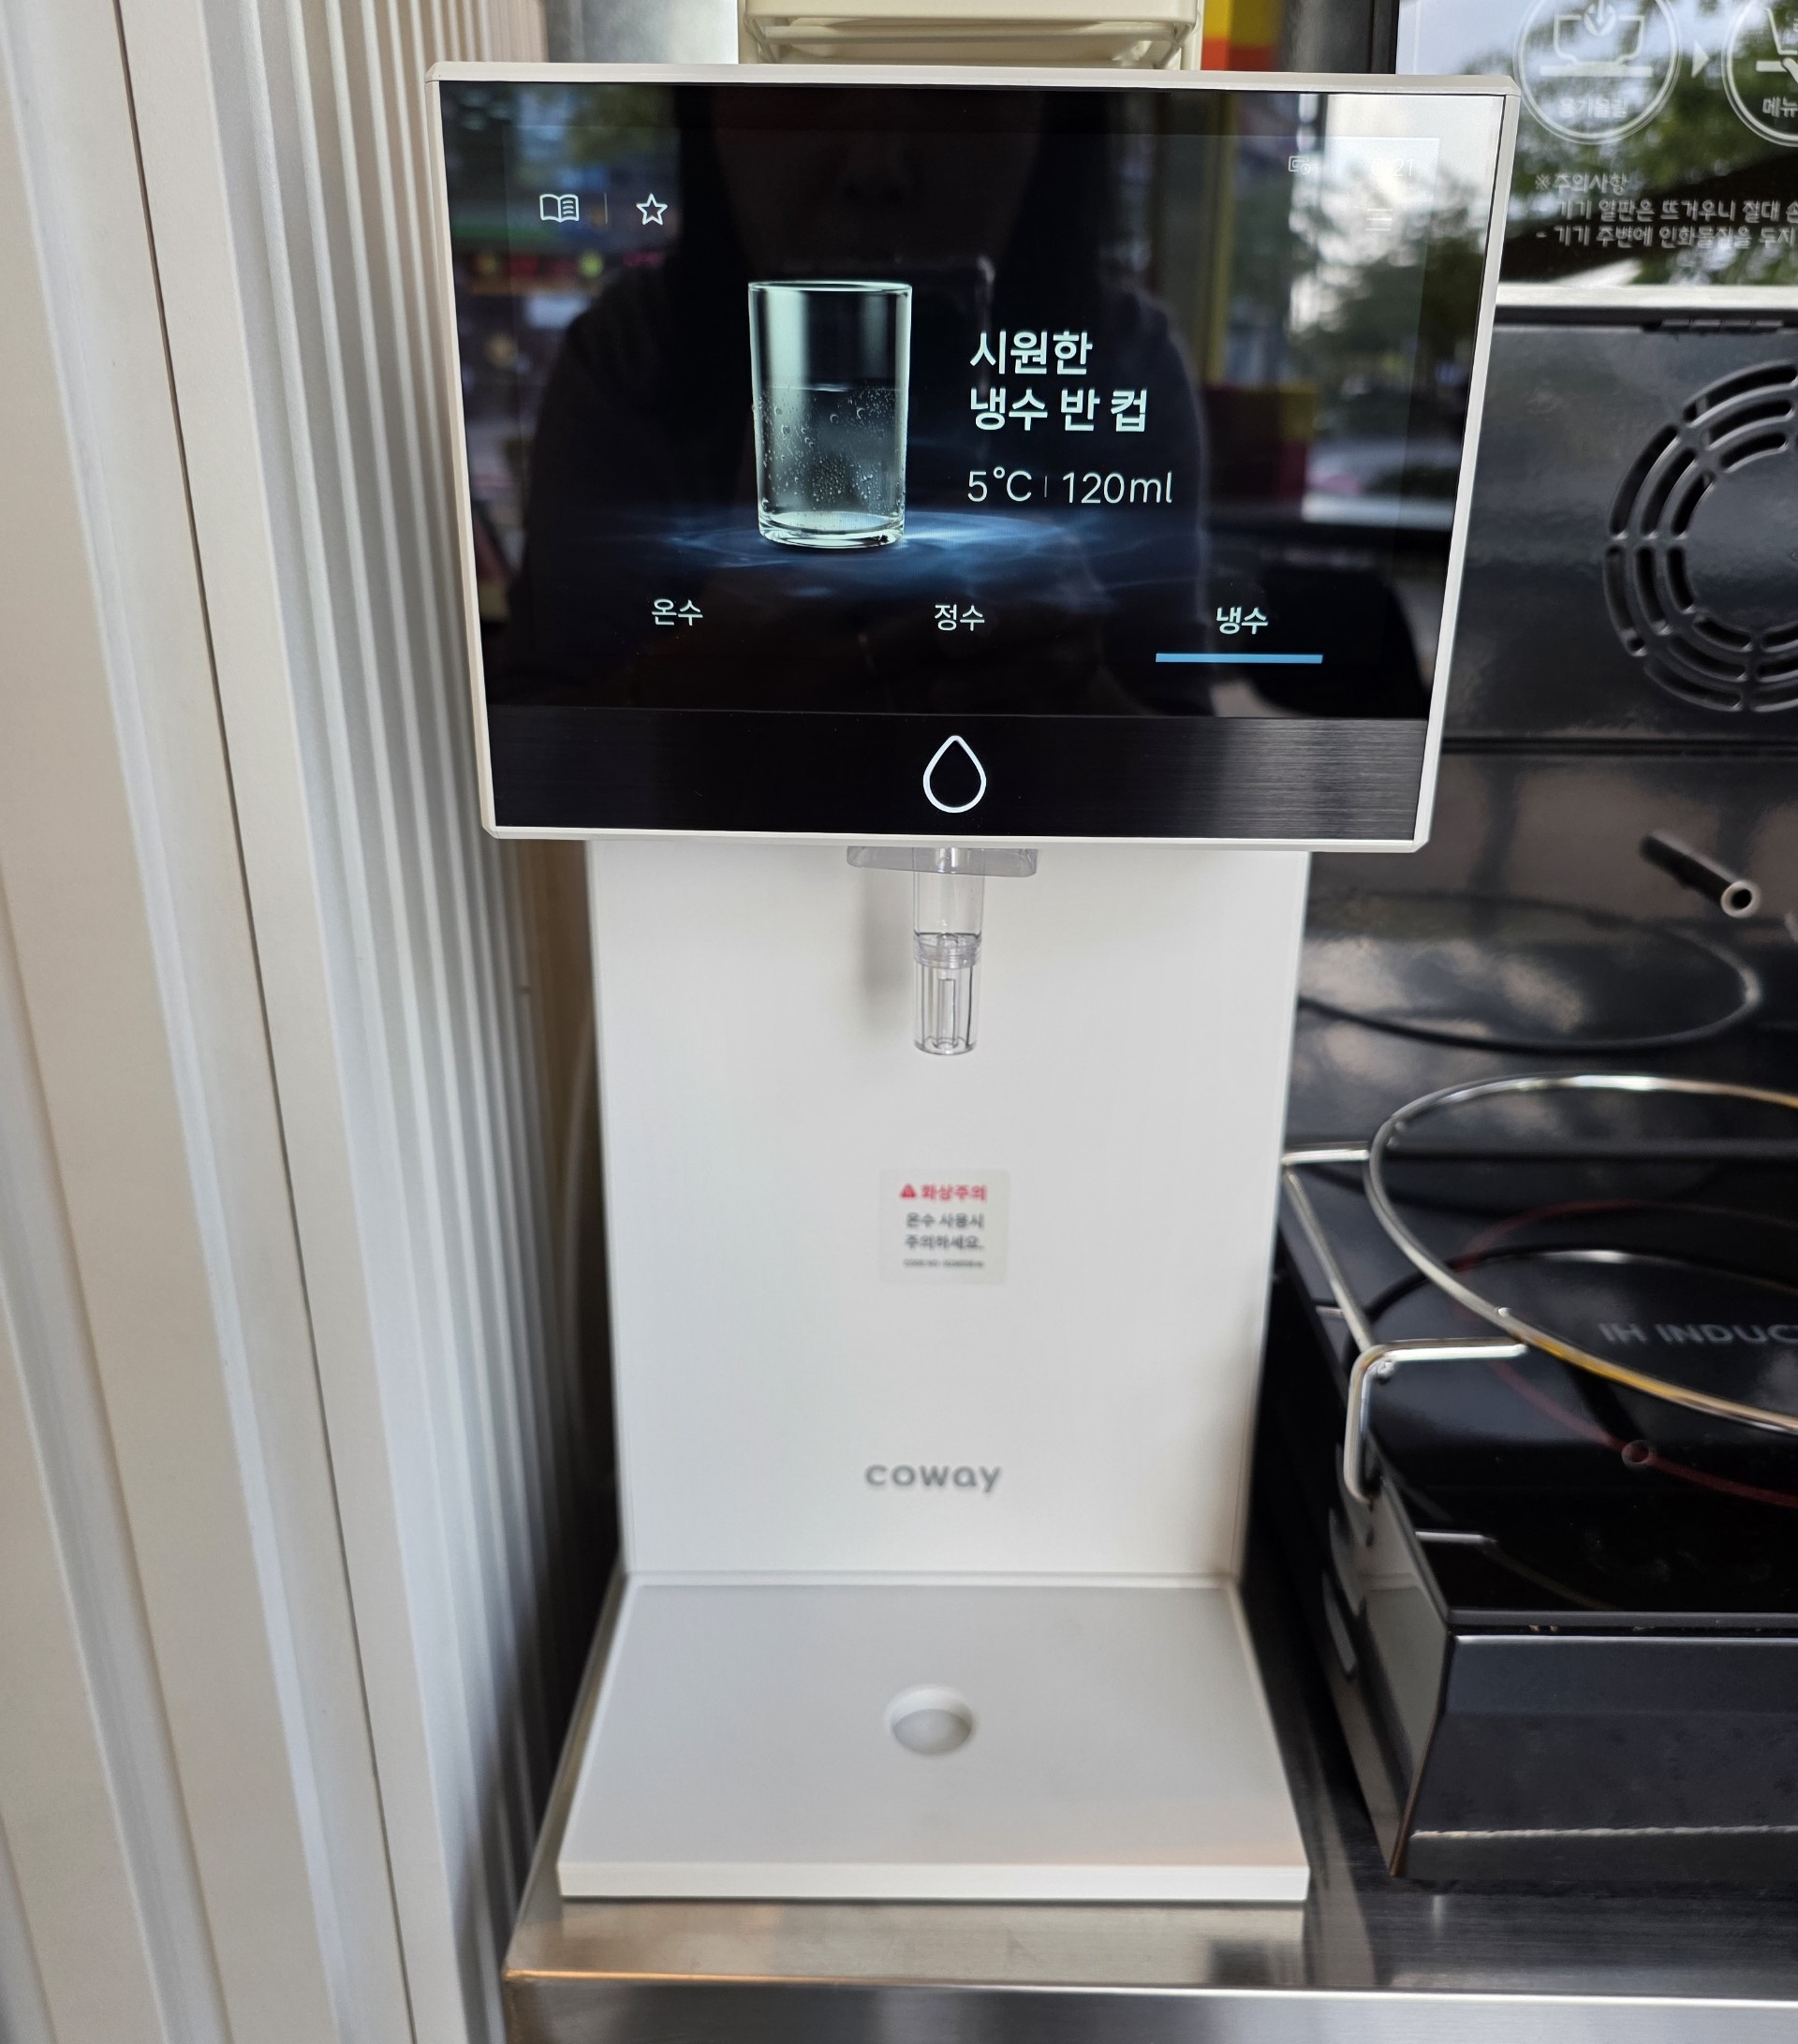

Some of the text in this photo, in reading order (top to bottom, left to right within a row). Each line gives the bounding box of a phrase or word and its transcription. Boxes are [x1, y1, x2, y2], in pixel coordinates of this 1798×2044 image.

[1599, 198, 1656, 223] 열판은
[1660, 199, 1737, 223] 뜨거우니
[1742, 199, 1781, 224] 절대
[1554, 225, 1591, 247] 기기
[1596, 225, 1653, 249] 주변에
[1658, 226, 1753, 250] 인화물질을
[969, 330, 1094, 375] 시원한
[970, 387, 1148, 433] 냉수 반 컵
[1062, 471, 1173, 505] 120ml
[651, 598, 703, 626] 온수
[934, 603, 985, 632] 정수
[1216, 607, 1269, 635] 냉수
[921, 1184, 987, 1202] 화상주의
[906, 1212, 984, 1229] 온수 사용시
[1598, 1322, 1647, 1343] IH
[864, 1463, 1002, 1493] coway
